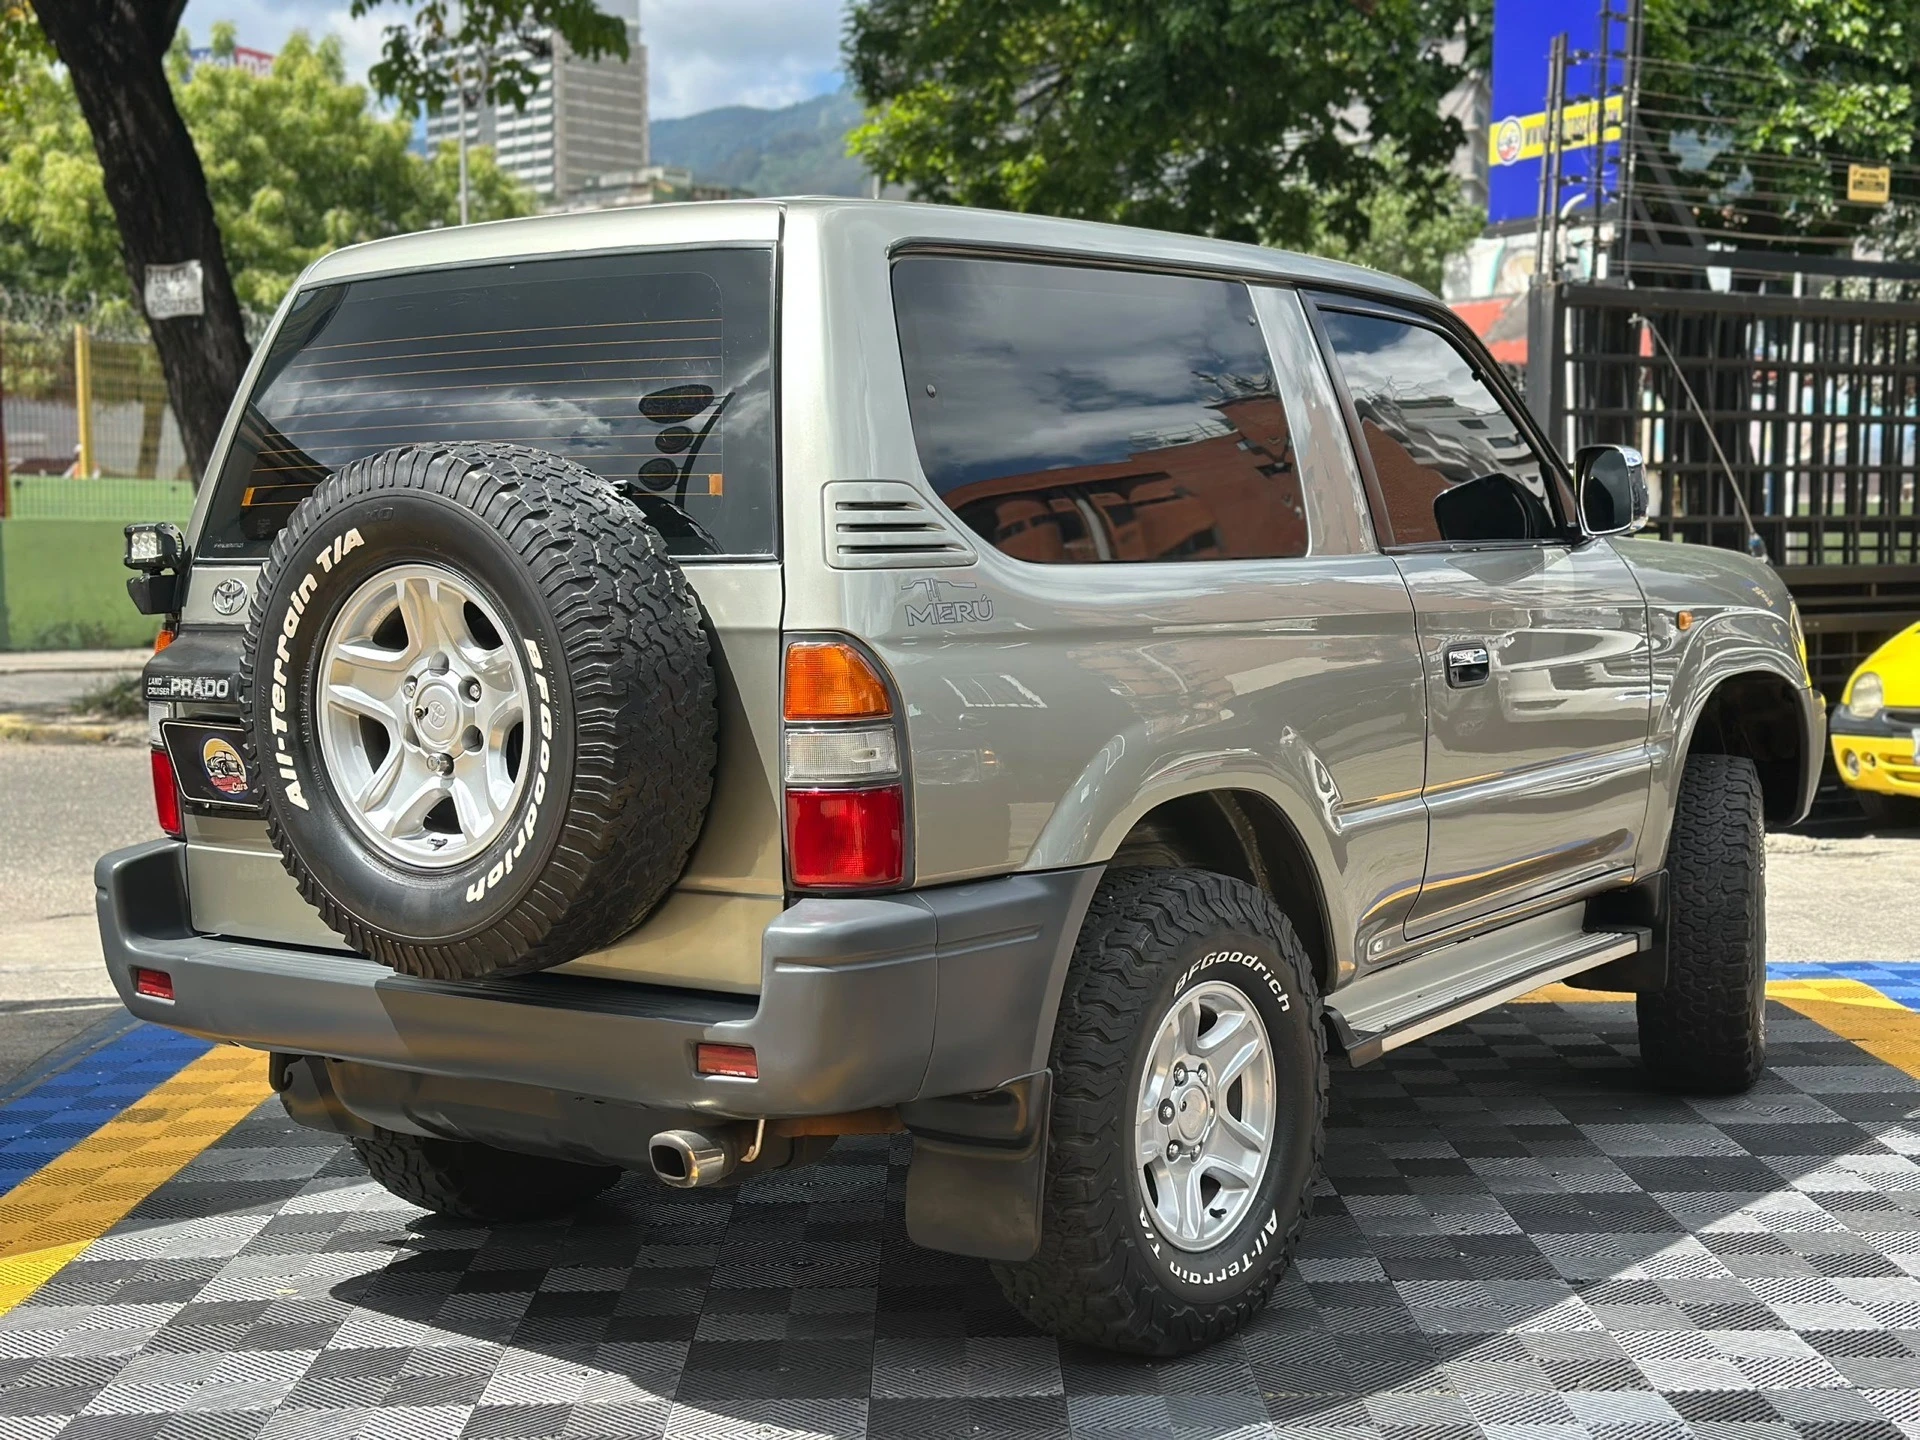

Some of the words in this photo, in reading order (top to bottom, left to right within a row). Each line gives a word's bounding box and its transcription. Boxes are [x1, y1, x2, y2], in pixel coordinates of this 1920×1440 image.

[905, 594, 993, 627] MERÚ
[147, 687, 170, 695] CRUISER
[148, 677, 163, 686] LAND
[170, 678, 229, 698] PRADO
[270, 573, 318, 811] All-Terrain
[316, 528, 365, 573] T/A
[466, 639, 552, 903] BFGoodrich
[1174, 951, 1290, 1012] BFGoodrich
[1139, 1206, 1160, 1260] T/A
[1169, 1208, 1278, 1285] All-Terrain
